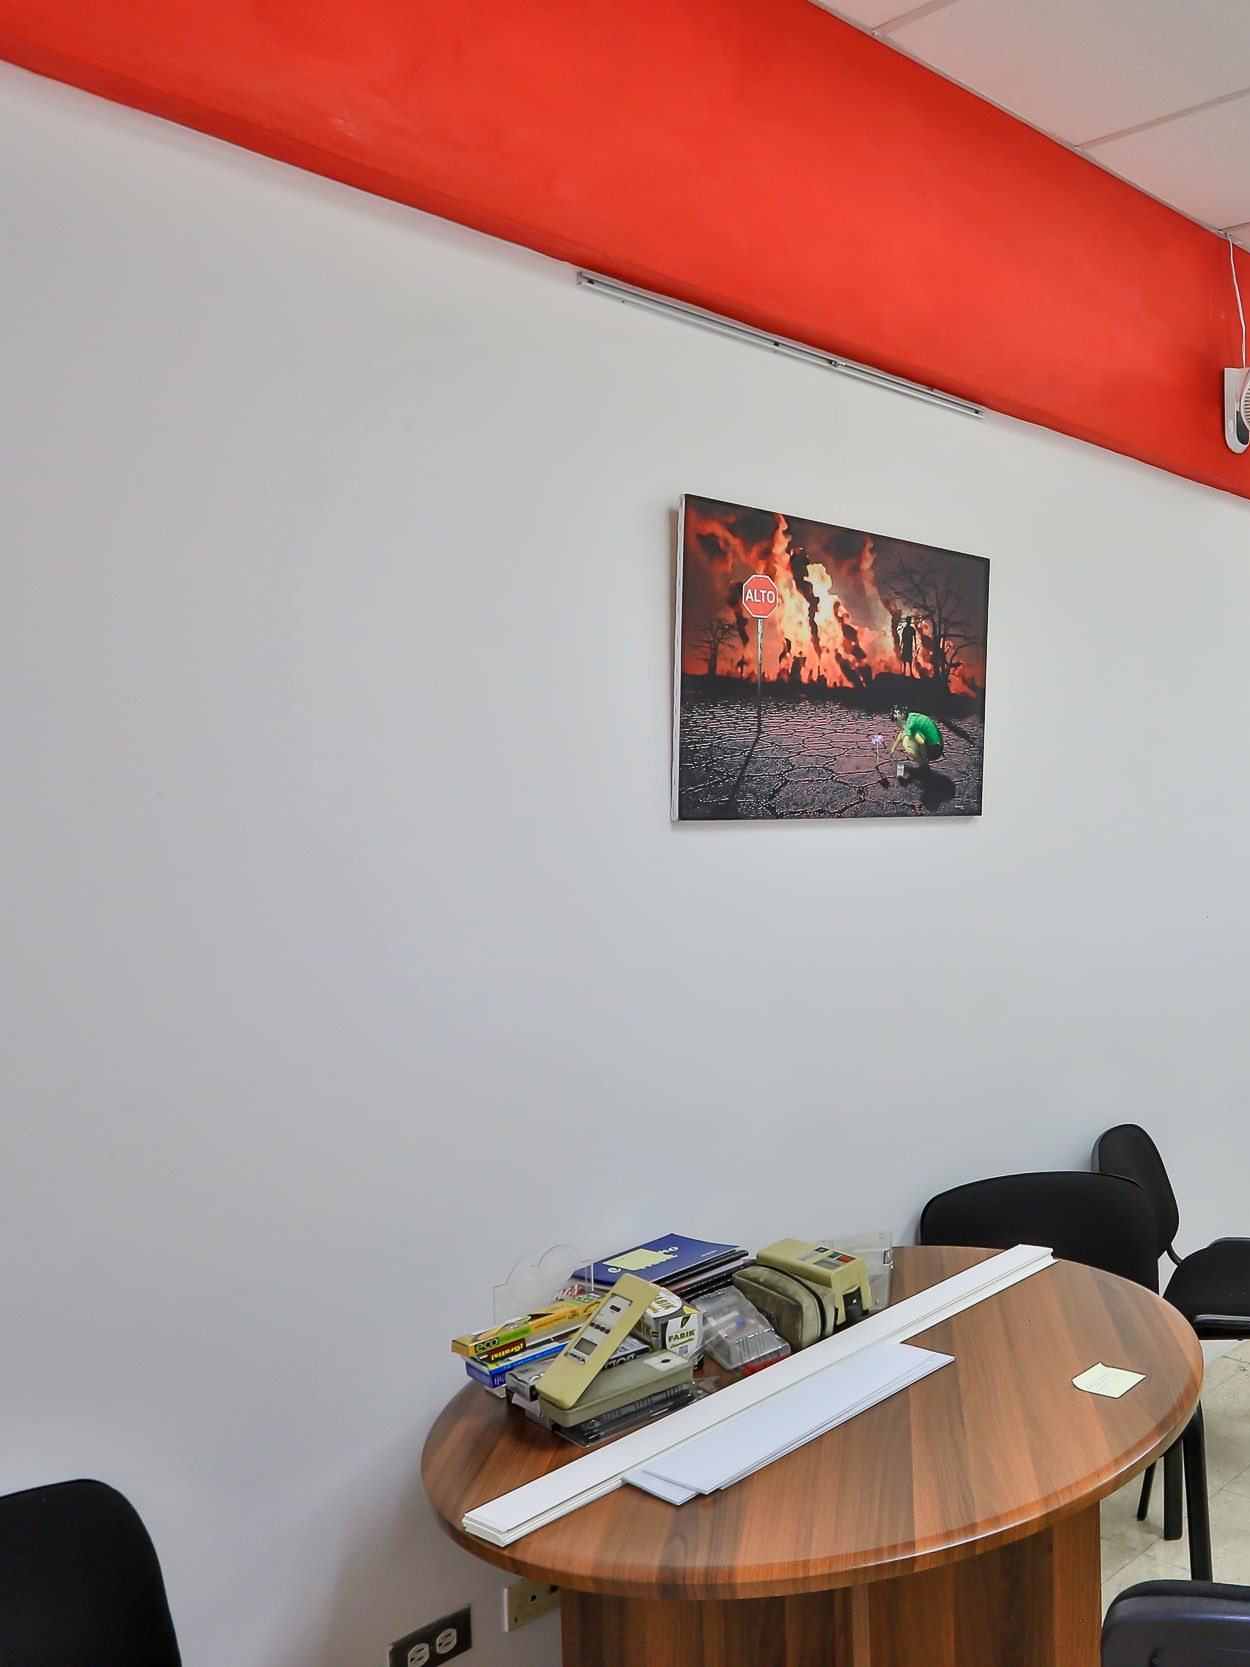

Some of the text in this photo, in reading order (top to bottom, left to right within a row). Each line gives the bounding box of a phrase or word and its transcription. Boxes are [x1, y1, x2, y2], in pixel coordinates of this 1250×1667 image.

[745, 588, 776, 604] ALTO
[668, 1330, 695, 1342] FABIK
[475, 1338, 499, 1352] eco
[491, 1343, 524, 1360] ¡Gratis!
